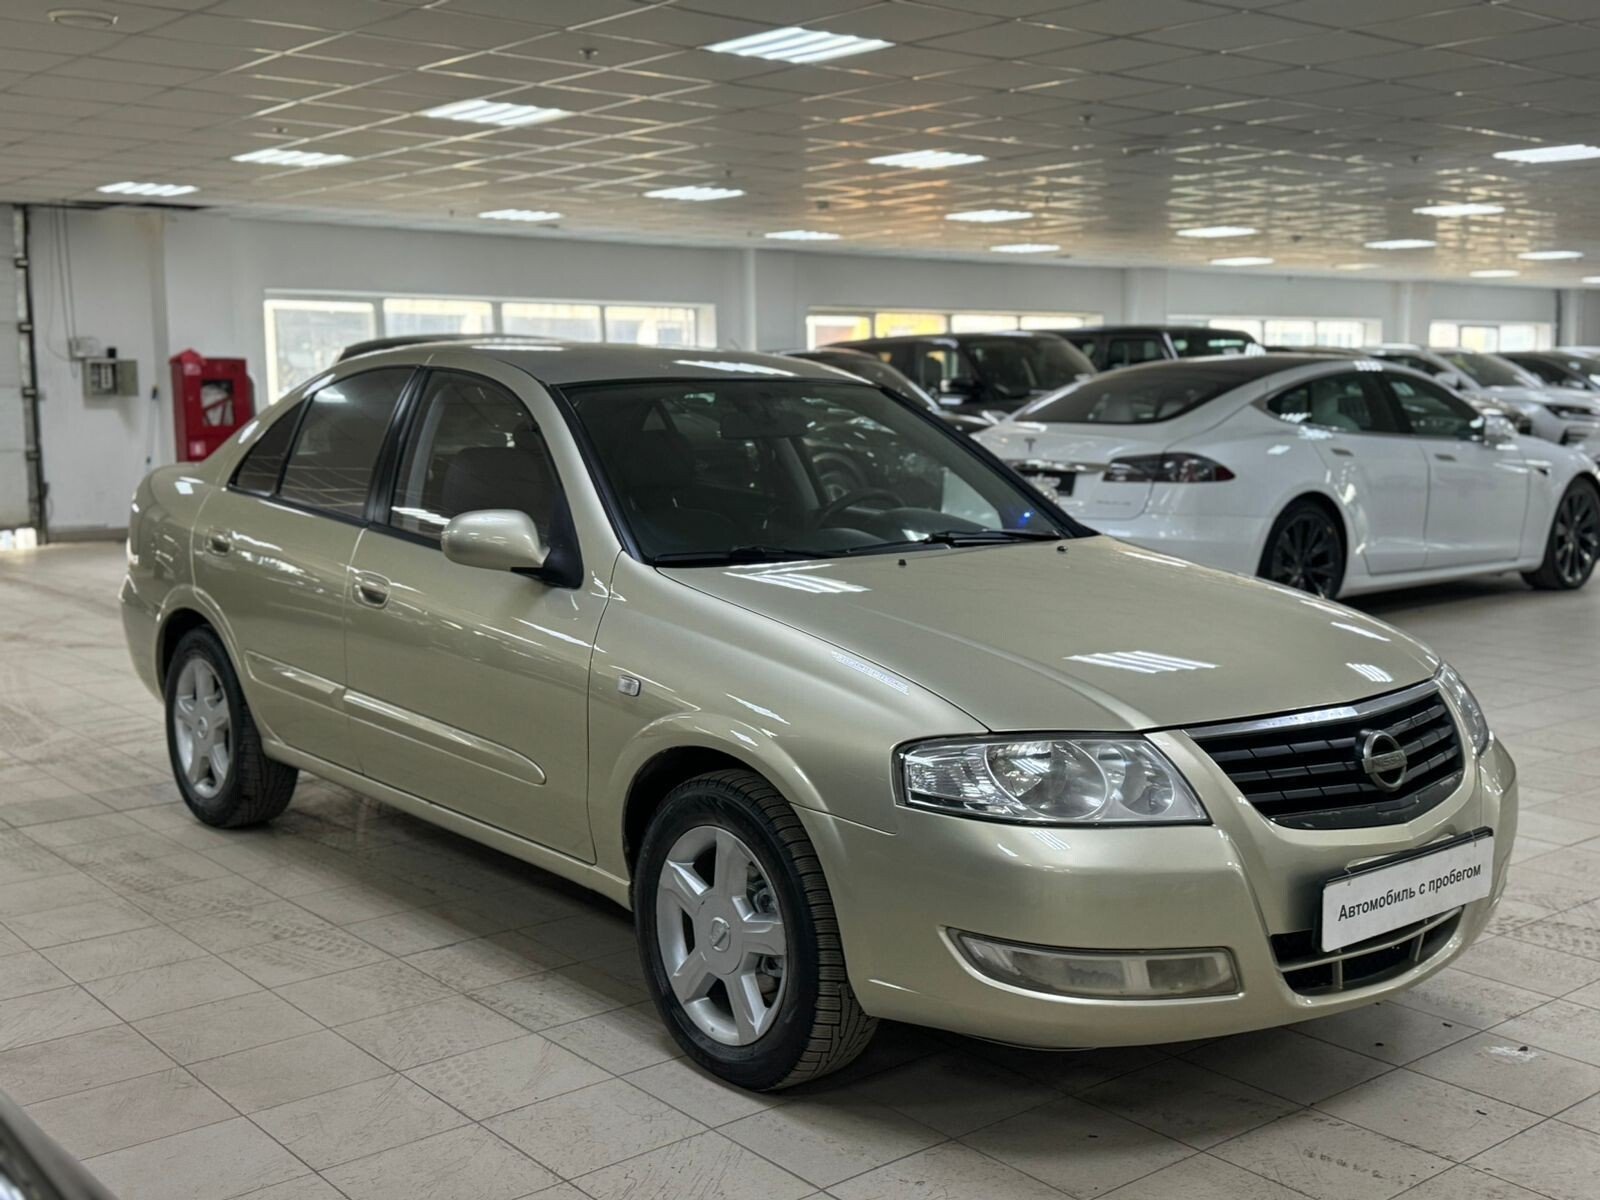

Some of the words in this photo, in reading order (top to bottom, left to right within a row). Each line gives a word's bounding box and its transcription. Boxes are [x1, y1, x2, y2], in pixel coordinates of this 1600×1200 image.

[1338, 887, 1416, 921] Автомобиль
[1419, 883, 1426, 895] с
[1428, 864, 1481, 894] пробегом
